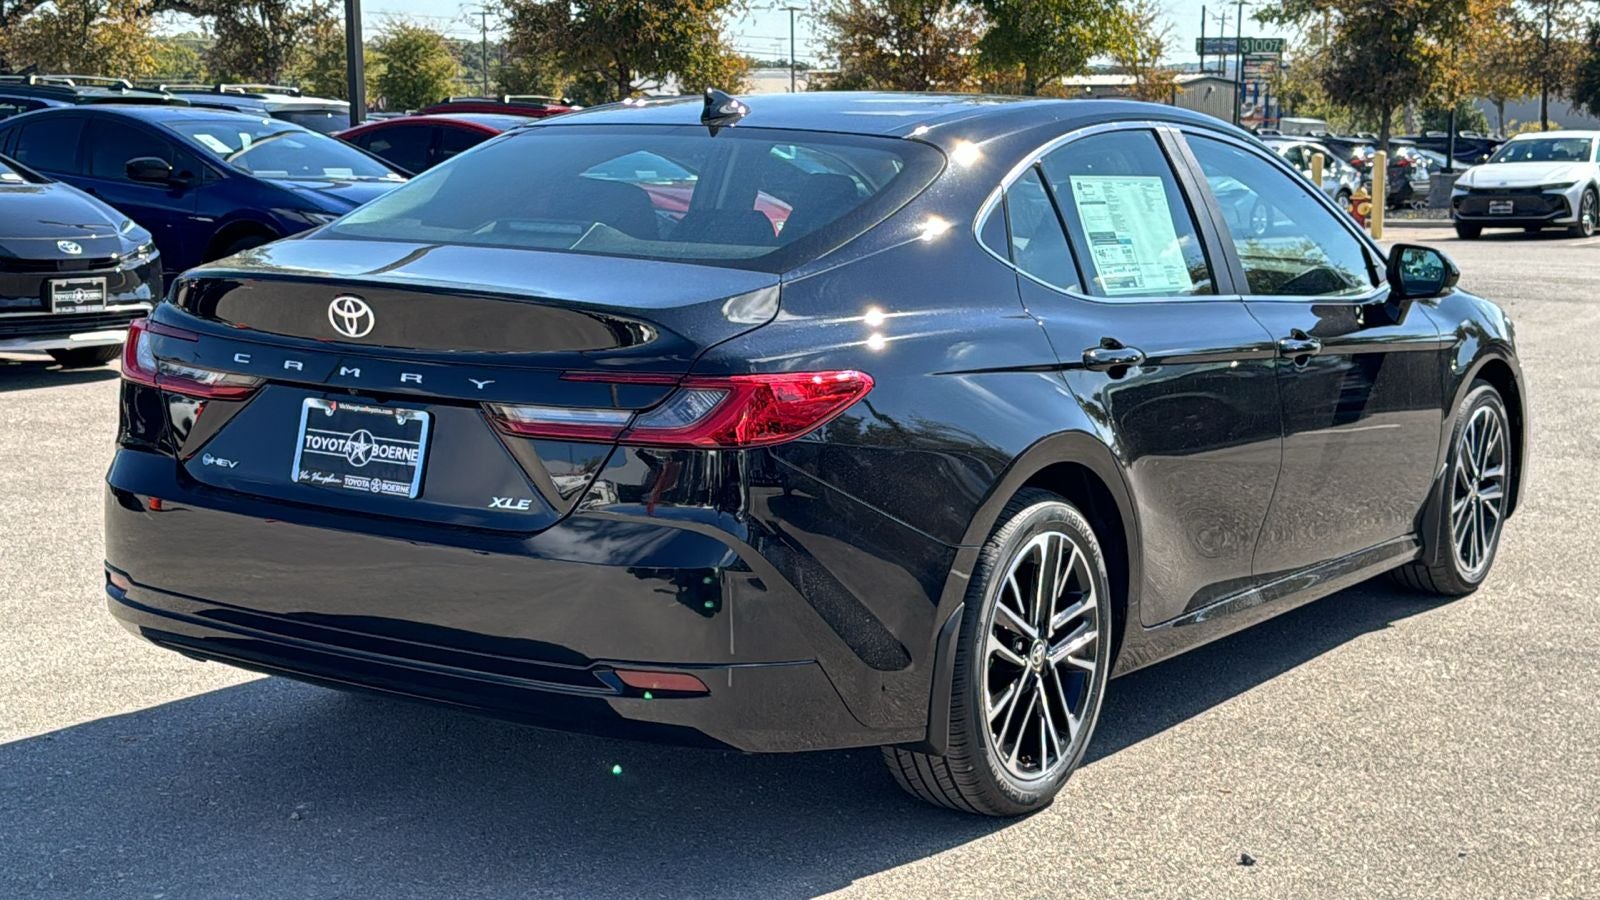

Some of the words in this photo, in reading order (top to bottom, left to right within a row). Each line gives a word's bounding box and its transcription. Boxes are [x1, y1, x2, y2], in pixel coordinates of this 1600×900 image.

[1241, 40, 1279, 53] 31007
[304, 435, 352, 453] TOYOTA
[371, 444, 419, 461] BOERNE
[344, 477, 370, 489] TOYOTA
[381, 483, 410, 494] BOERNE
[487, 496, 532, 510] XLE
